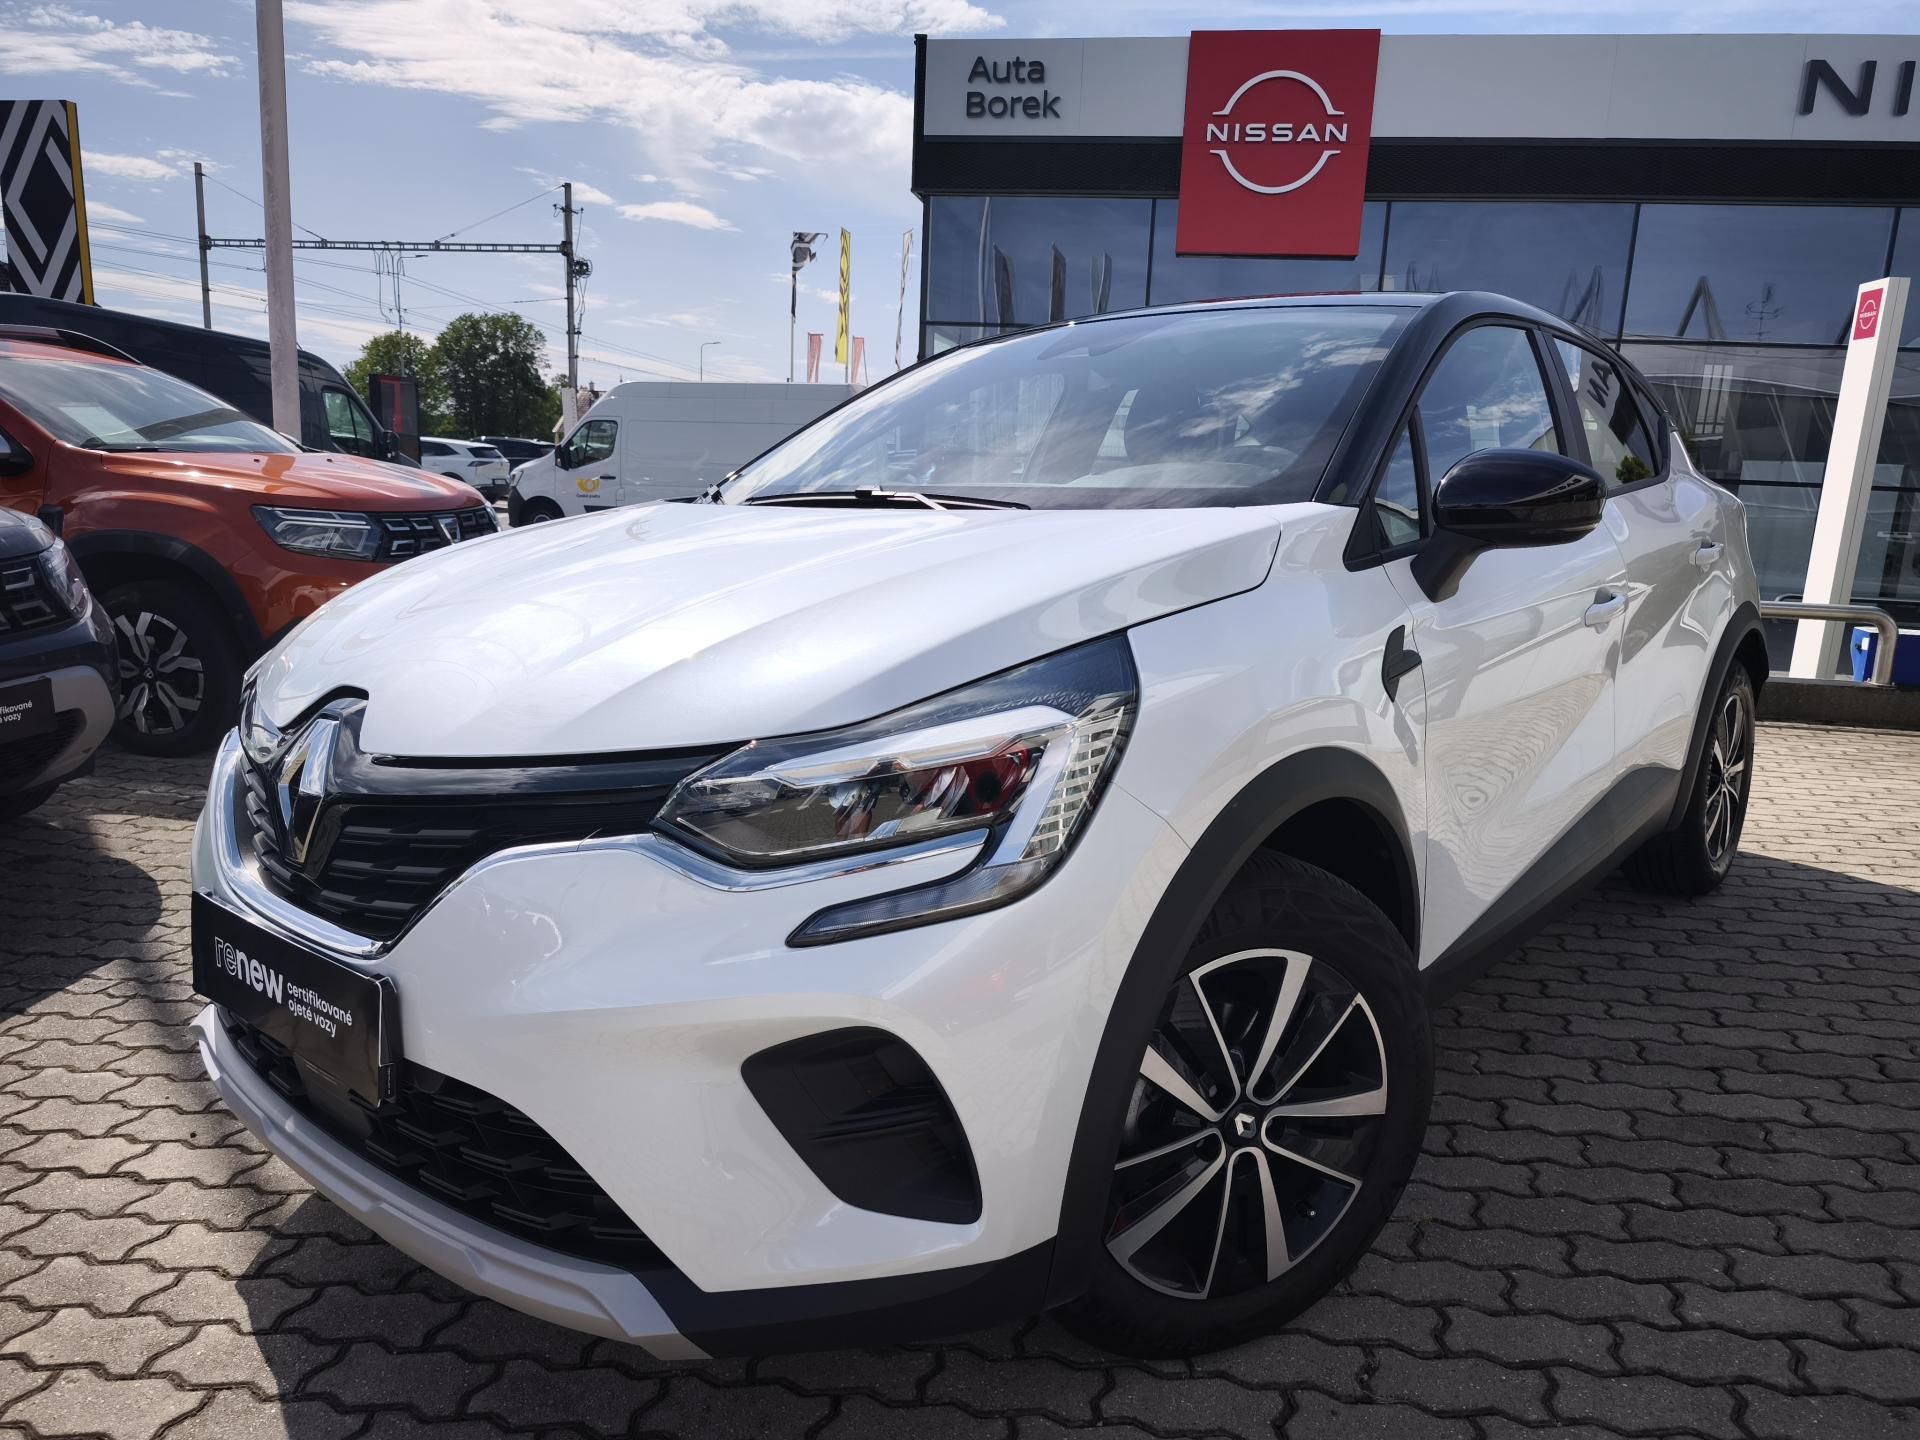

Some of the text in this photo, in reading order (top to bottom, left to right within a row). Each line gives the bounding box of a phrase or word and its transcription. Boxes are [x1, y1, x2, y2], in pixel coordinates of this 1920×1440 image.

[967, 56, 1045, 84] Auta
[1799, 59, 1917, 117] NI
[966, 89, 1061, 119] Borek
[1206, 123, 1348, 143] NISSAN
[214, 936, 284, 1004] renew
[286, 982, 353, 1026] certifikované
[288, 999, 337, 1038] ojeté vozy
